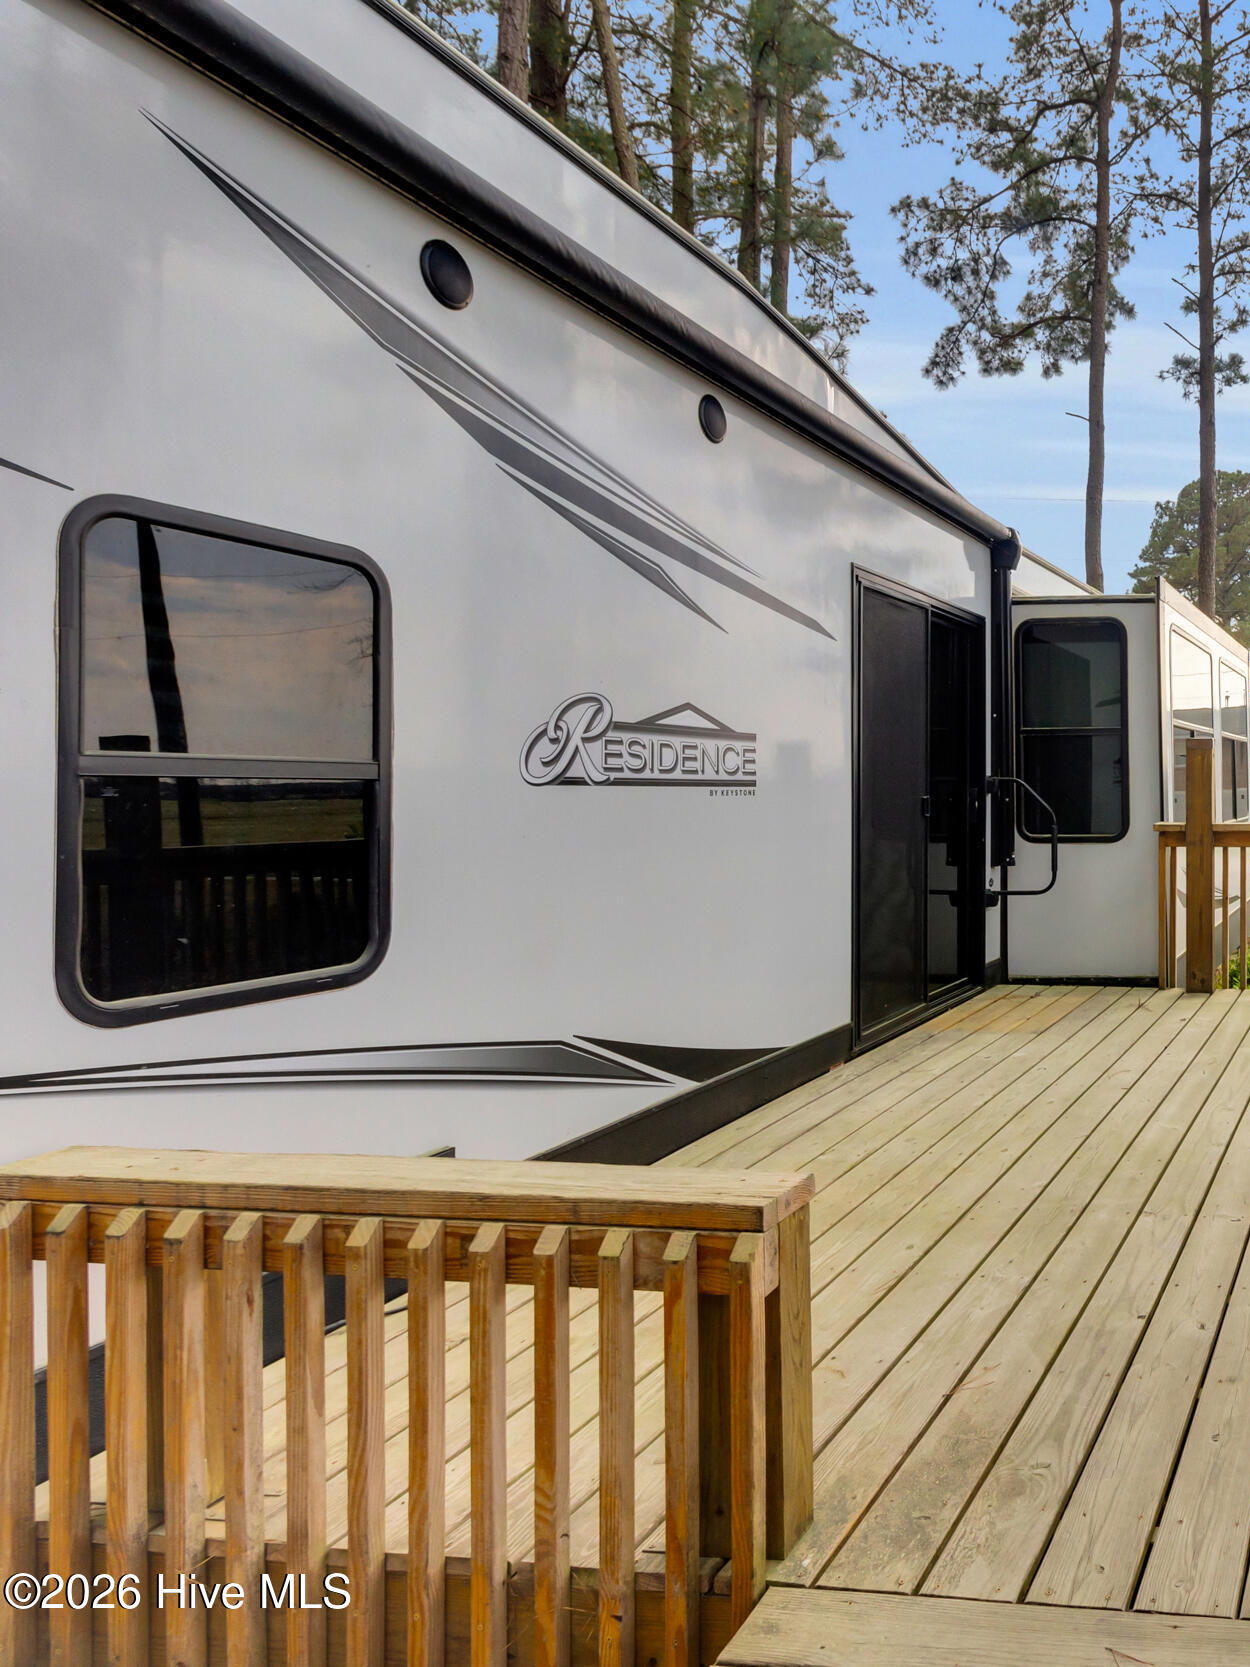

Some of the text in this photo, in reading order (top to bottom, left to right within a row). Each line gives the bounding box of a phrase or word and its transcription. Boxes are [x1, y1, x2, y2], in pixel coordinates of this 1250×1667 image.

[519, 692, 757, 786] RESIDENCE
[709, 789, 756, 797] BY KEYSTONE
